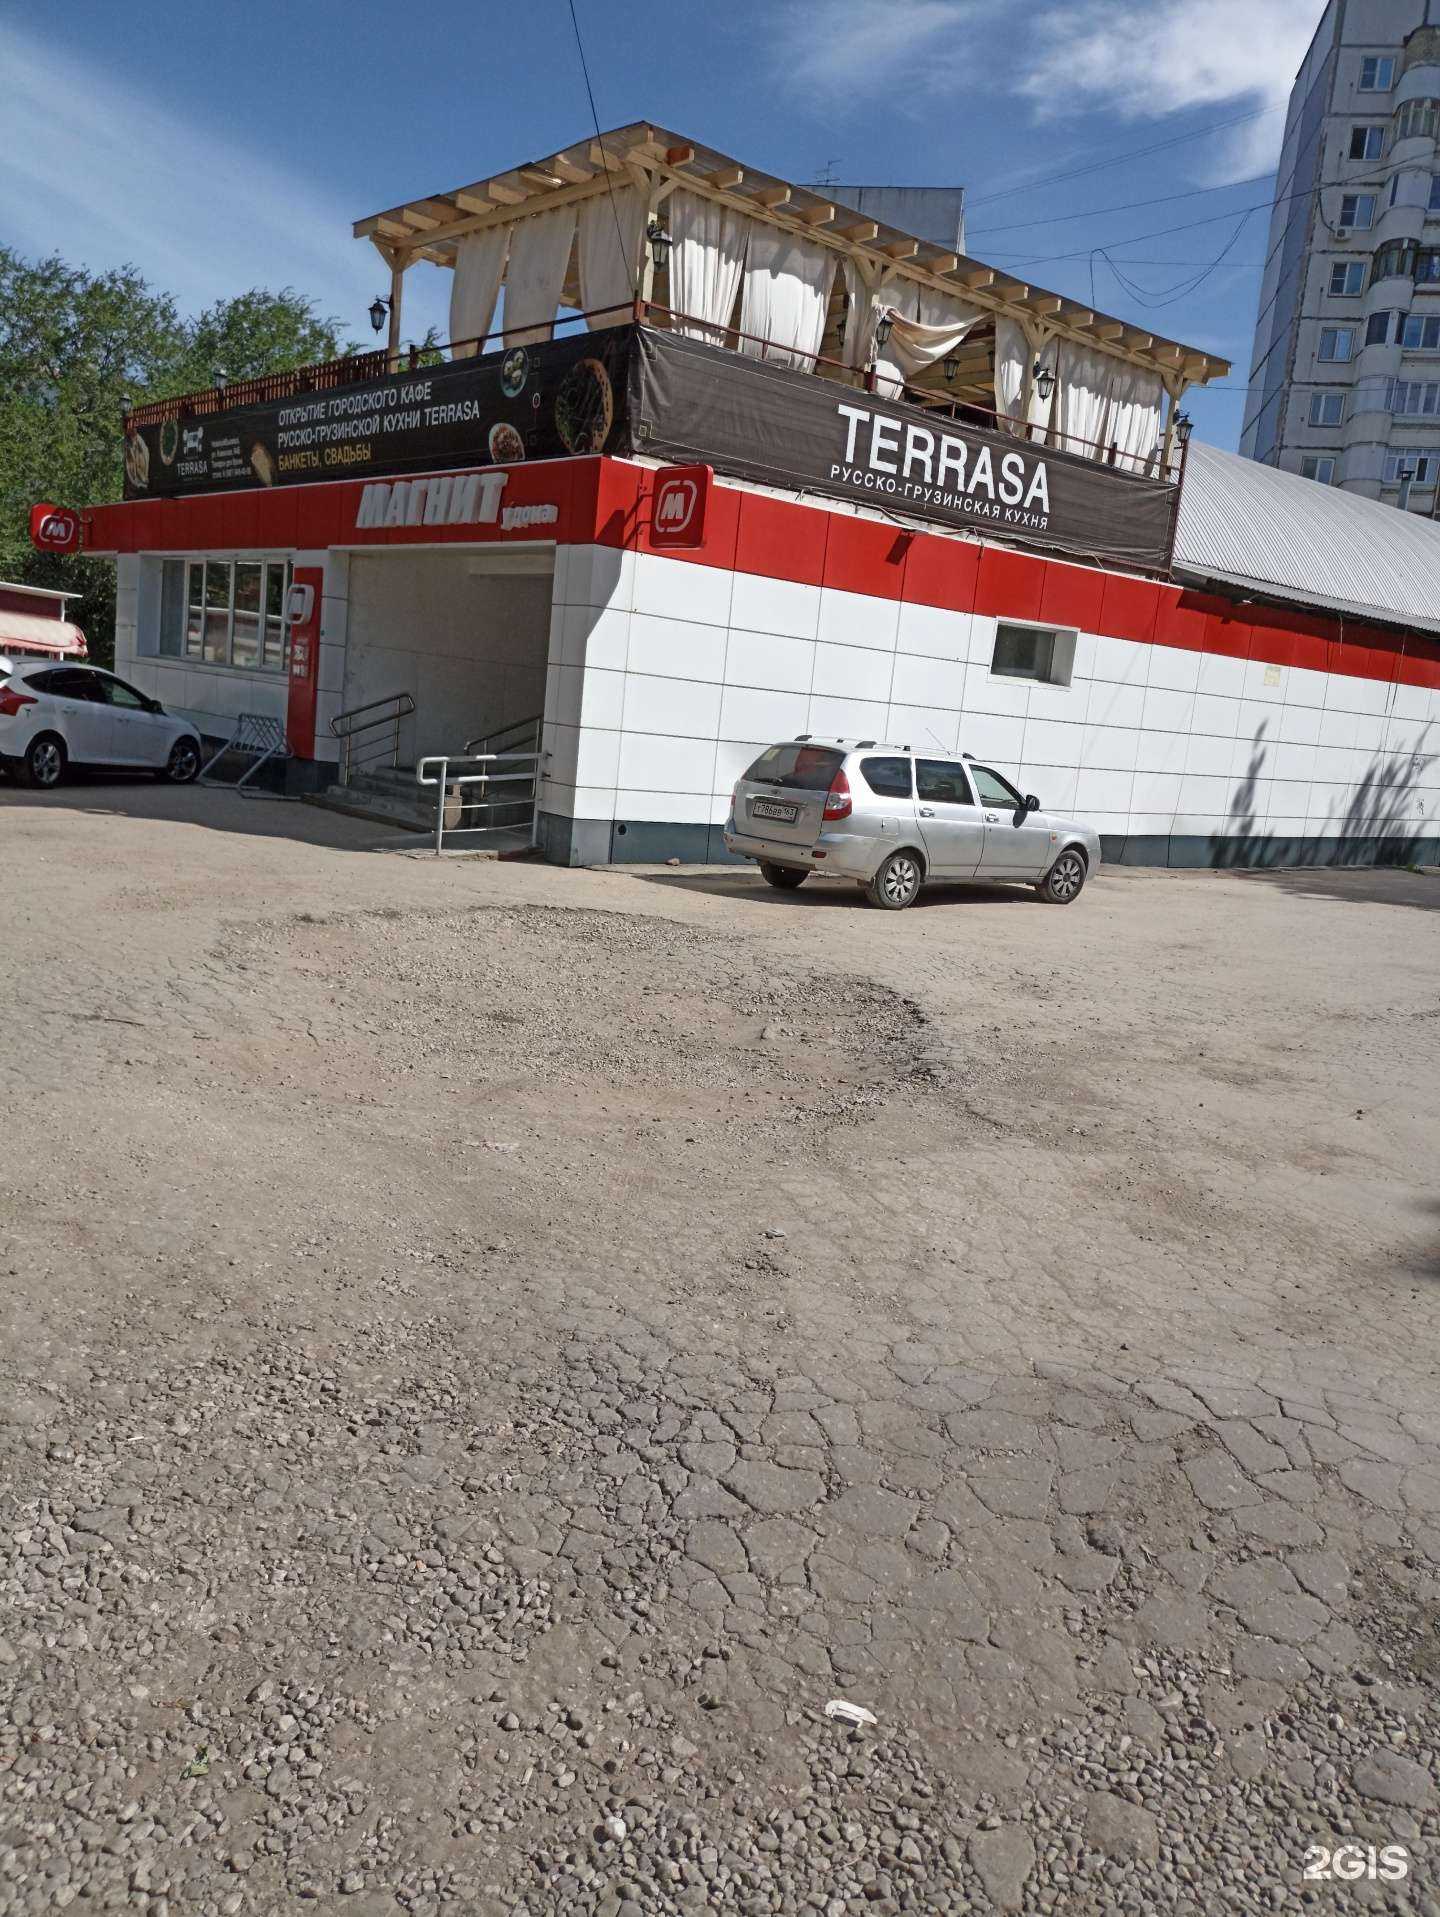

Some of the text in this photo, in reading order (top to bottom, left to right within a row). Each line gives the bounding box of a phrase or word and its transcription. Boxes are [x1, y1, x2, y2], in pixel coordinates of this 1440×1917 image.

[278, 381, 433, 426] ОТКРЫТИЕ ГОРОДСКОГО КАФЕ
[278, 399, 480, 448] РУССКО-ГРУЗИНСКОЙ КУХНИ TERRASA
[177, 461, 208, 476] TERRASA
[278, 443, 371, 471] БАНКЕТЫ, СВАДЬБЫ
[838, 404, 1050, 513] TERRASA
[355, 472, 509, 528] МАГНИТ
[830, 464, 1049, 530] РУССКО-ГРУЗИНСКАЯ КУХНЯ
